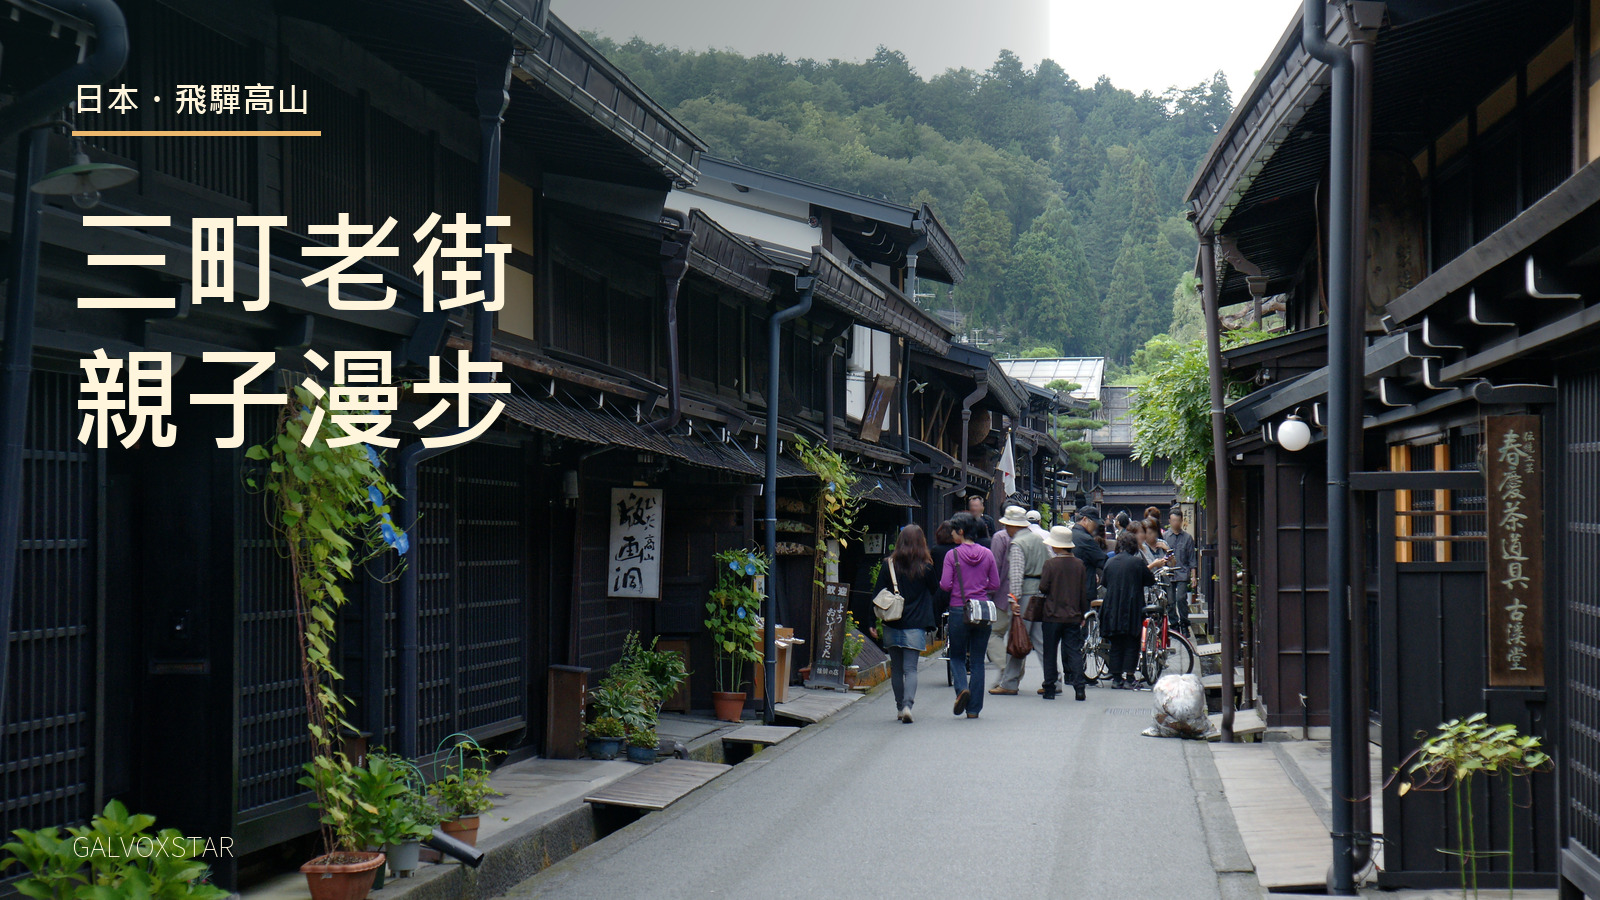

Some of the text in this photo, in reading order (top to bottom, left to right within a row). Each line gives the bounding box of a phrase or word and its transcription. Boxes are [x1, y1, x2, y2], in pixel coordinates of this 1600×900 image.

[1523, 431, 1536, 474] 伝統工芸
[1498, 429, 1530, 590] 春慶茶道具
[836, 603, 845, 624] よう
